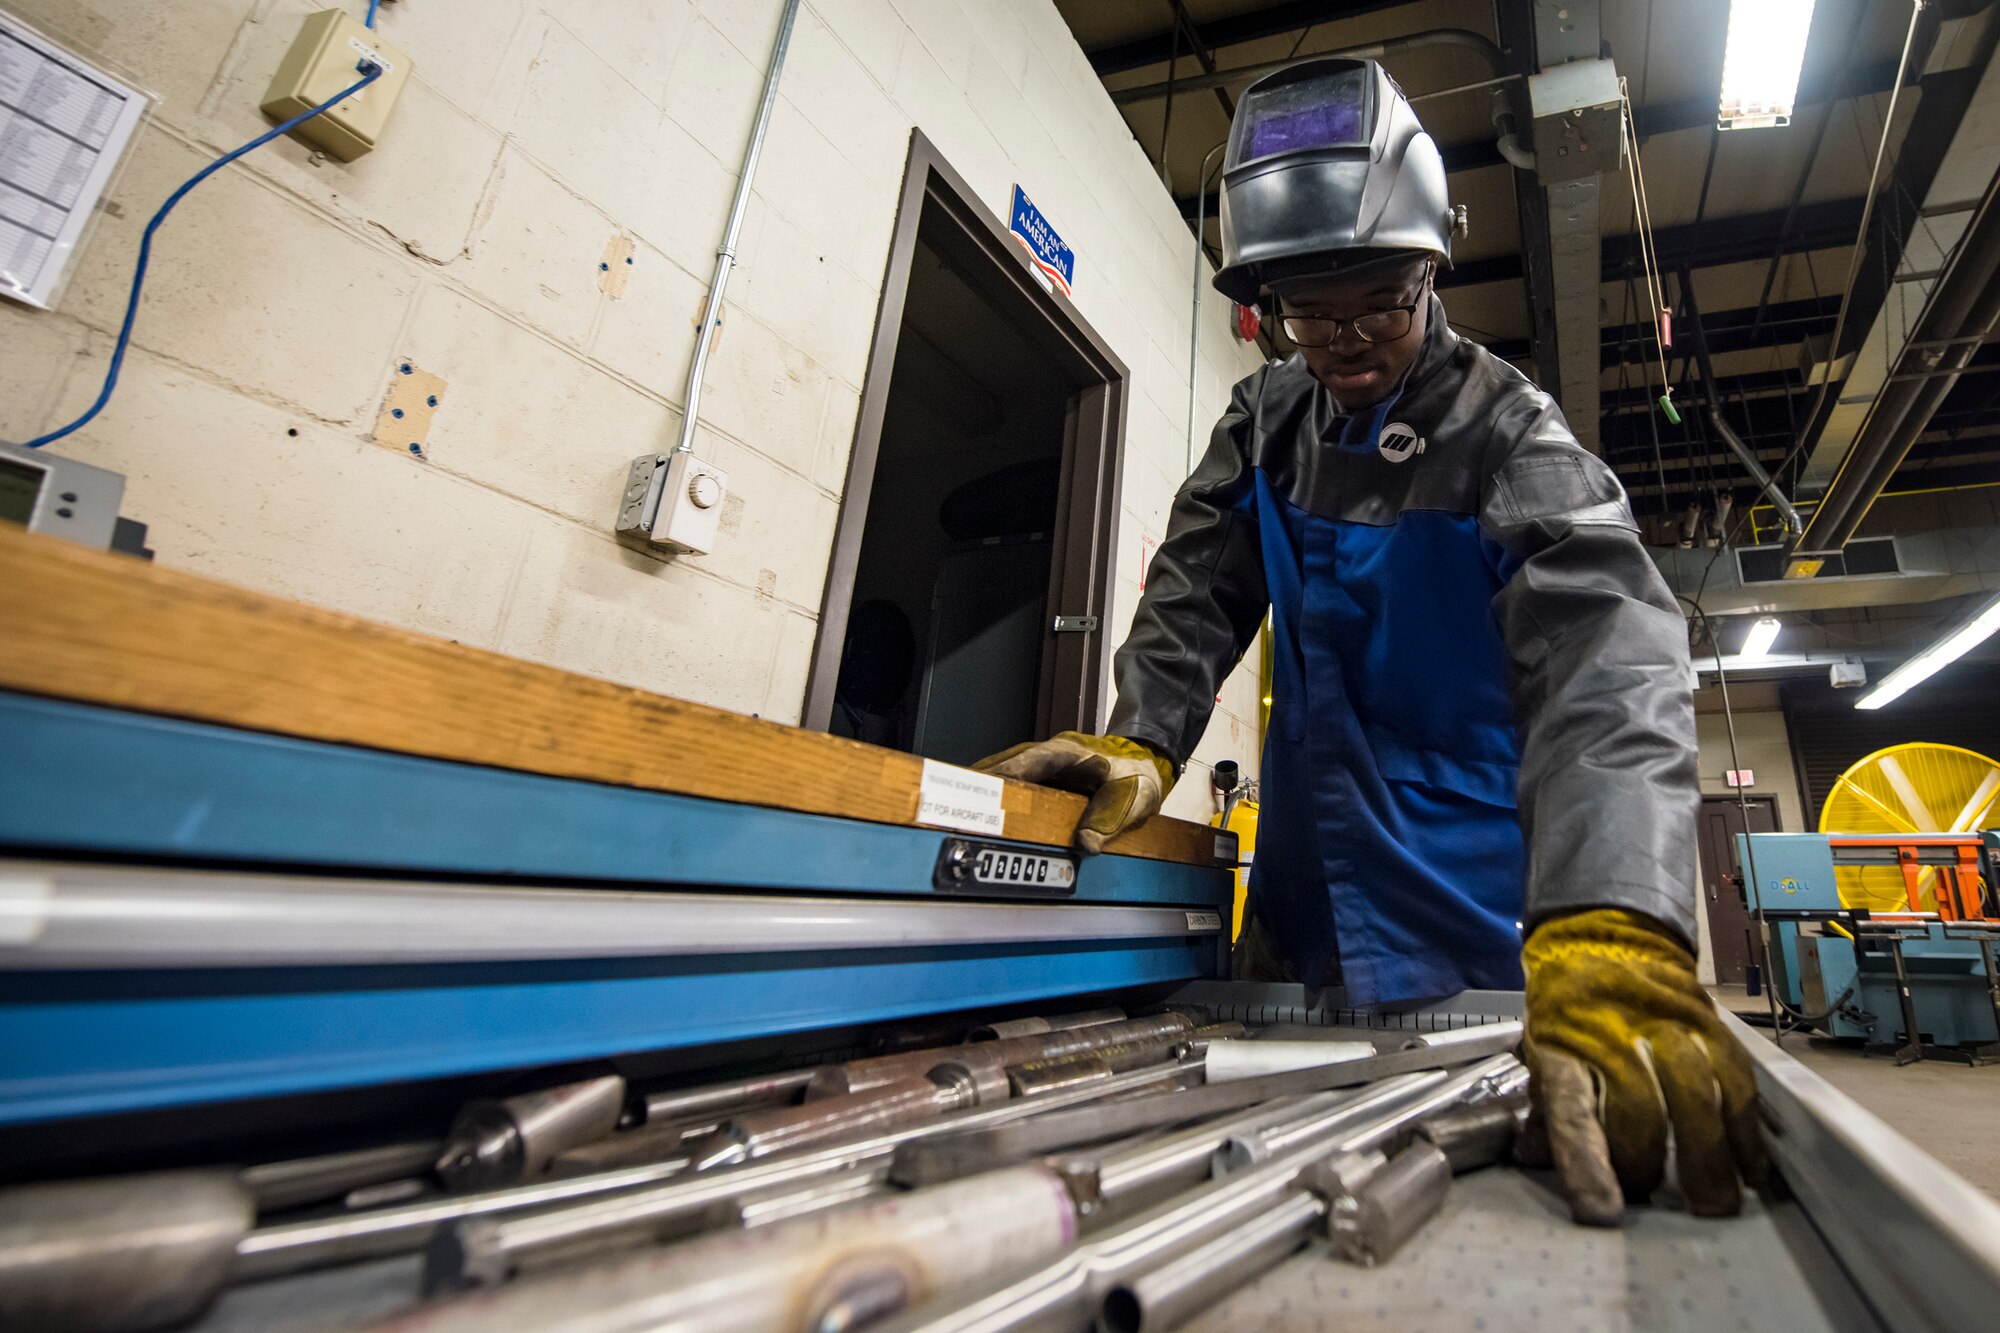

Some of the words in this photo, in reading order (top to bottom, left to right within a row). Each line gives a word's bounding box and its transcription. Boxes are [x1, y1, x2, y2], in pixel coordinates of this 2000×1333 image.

[1018, 212, 1067, 276] AMERICAN
[1034, 217, 1047, 238] AM
[1048, 234, 1060, 252] AN
[934, 803, 949, 816] FOR
[951, 807, 984, 822] AIRCRAFT
